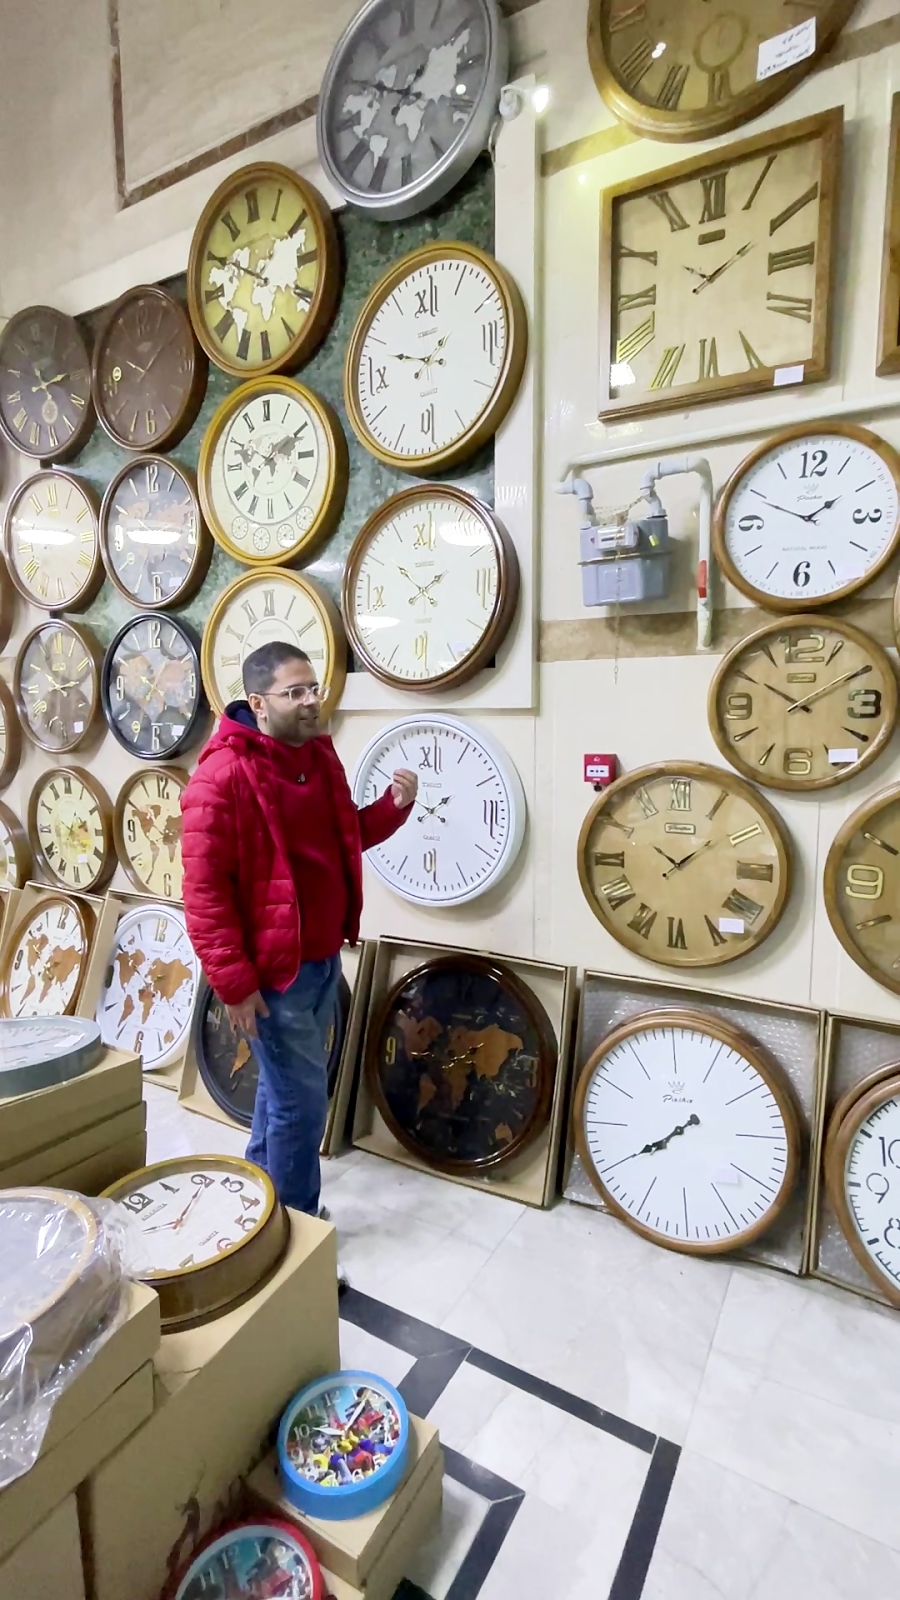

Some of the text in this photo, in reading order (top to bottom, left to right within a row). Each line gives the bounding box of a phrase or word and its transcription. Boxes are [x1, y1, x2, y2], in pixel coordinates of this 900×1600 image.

[699, 171, 728, 224] XII
[769, 182, 818, 237] II
[648, 191, 690, 233] XI
[768, 241, 815, 275] III
[699, 337, 722, 380] VI
[798, 449, 829, 479] 12
[146, 465, 160, 493] 12
[738, 514, 765, 532] 9
[852, 507, 882, 525] 3
[115, 525, 124, 551] 9
[793, 560, 811, 588] 6
[149, 621, 160, 649] 12
[779, 634, 825, 664] 12
[116, 675, 124, 701] 9
[726, 692, 752, 720] 9
[847, 689, 882, 719] 3
[151, 725, 160, 751] 6
[783, 748, 813, 776] 6
[157, 775, 170, 800] 12
[667, 779, 692, 811] XII
[636, 787, 659, 819] XI
[706, 790, 729, 820] I
[128, 819, 137, 843] 9
[728, 821, 764, 848] II
[601, 874, 637, 911] VIII
[845, 864, 883, 900] 9
[155, 918, 168, 943] 12
[627, 902, 658, 940] VII
[667, 916, 688, 950] VI
[704, 914, 728, 946] V
[134, 1031, 144, 1054] 6
[386, 1036, 397, 1065] 9
[159, 1181, 180, 1194] 1
[190, 1173, 216, 1189] 2
[220, 1176, 245, 1193] 3
[866, 1172, 890, 1204] 9
[121, 1192, 154, 1215] 12
[239, 1194, 261, 1211] 4
[234, 1214, 258, 1233] 5
[294, 1423, 310, 1441] 10
